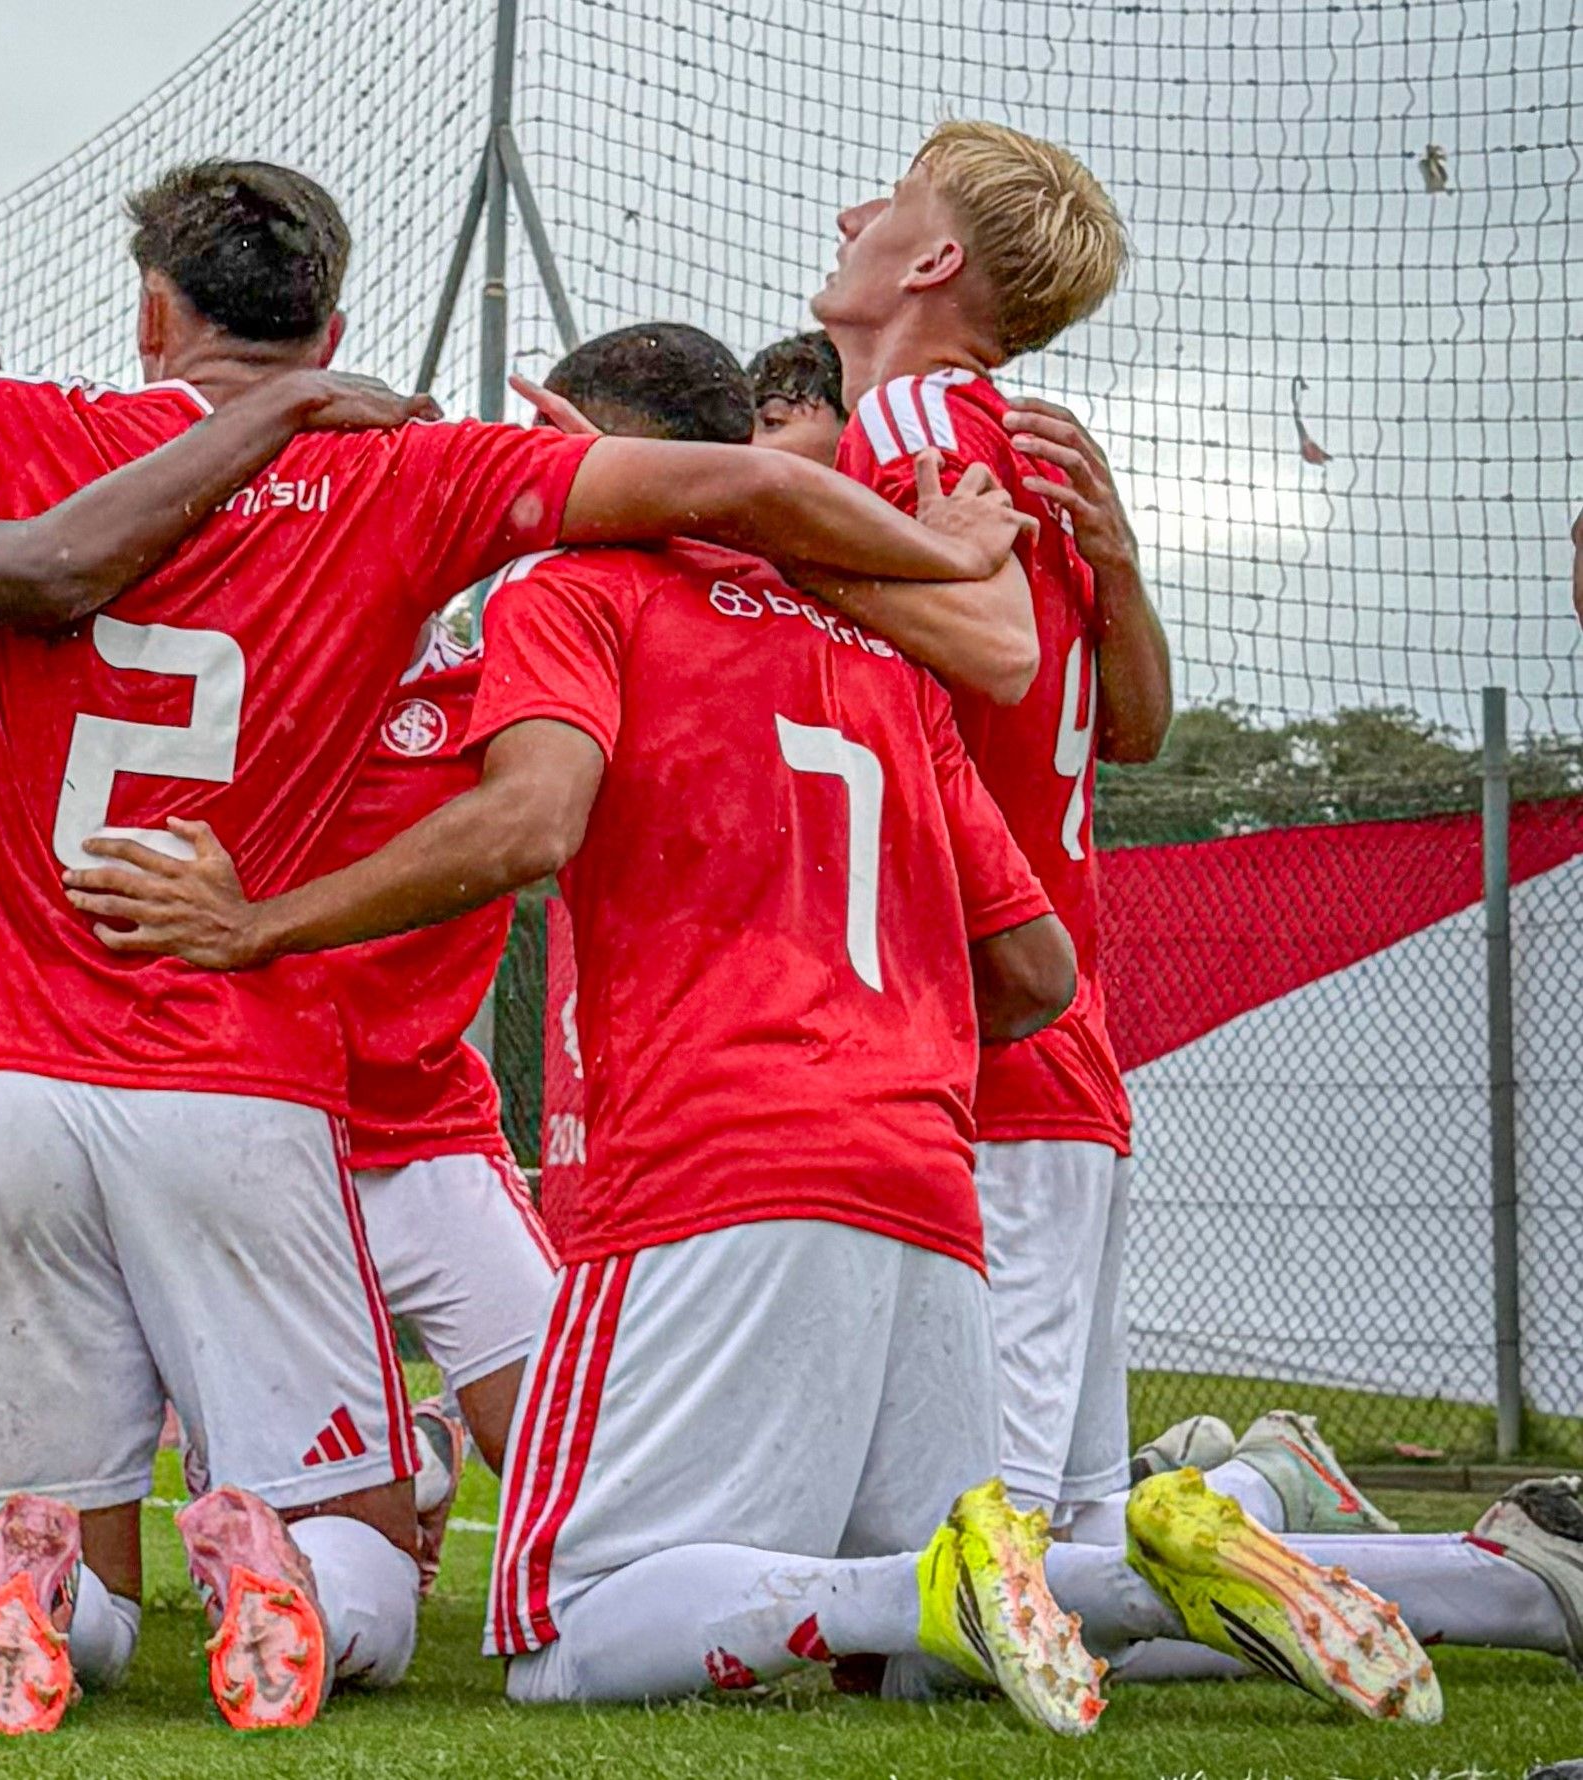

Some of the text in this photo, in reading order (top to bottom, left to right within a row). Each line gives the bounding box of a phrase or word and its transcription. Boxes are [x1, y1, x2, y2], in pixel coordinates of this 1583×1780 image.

[216, 473, 330, 516] nrisul
[53, 614, 246, 870] 2
[775, 713, 883, 993] 7
